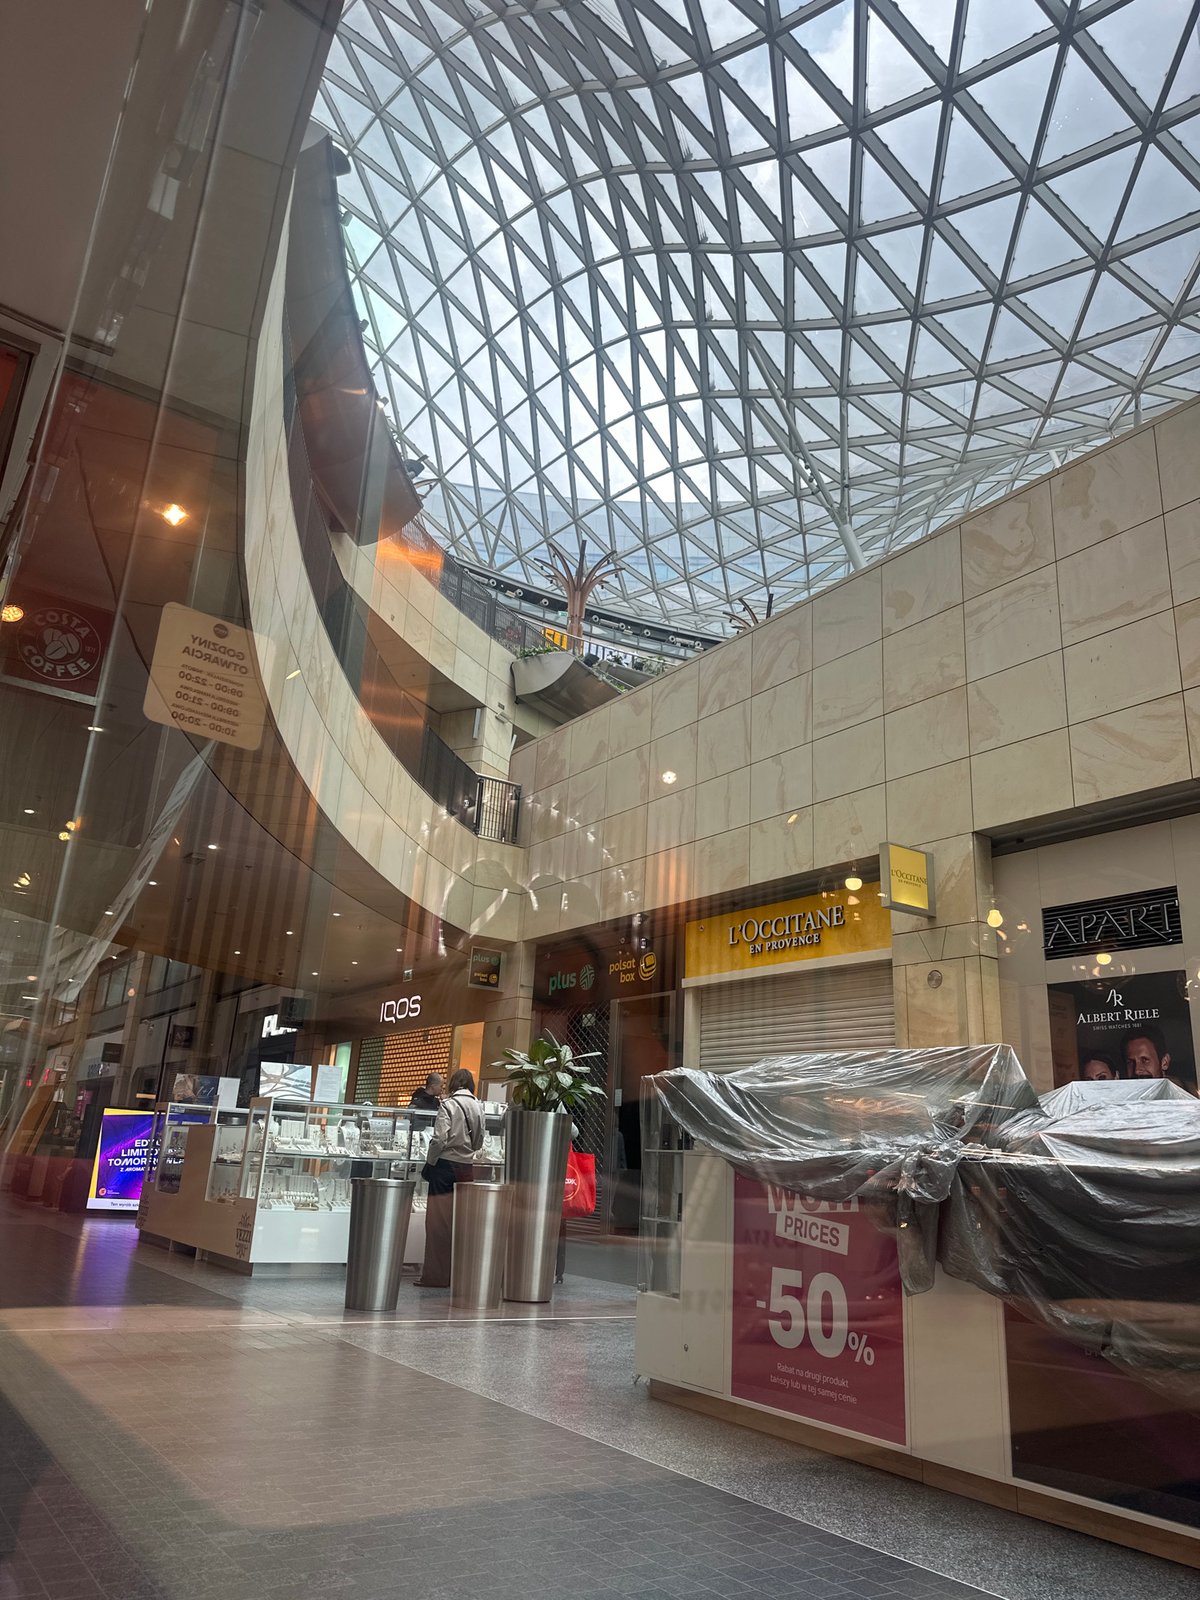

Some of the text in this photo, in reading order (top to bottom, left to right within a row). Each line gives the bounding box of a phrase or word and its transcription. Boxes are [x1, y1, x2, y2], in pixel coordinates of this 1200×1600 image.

[35, 611, 90, 638] COSTA
[24, 645, 91, 677] COFFEE
[728, 905, 845, 945] L'OCCITANE
[1044, 900, 1179, 948] APART
[749, 933, 821, 954] EN PROVENCE
[473, 954, 490, 963] plus
[609, 958, 636, 975] polsat
[548, 971, 577, 995] plus
[620, 972, 635, 983] box
[380, 995, 421, 1024] IQOS
[1077, 1008, 1160, 1025] ALBERT RIELE
[784, 1215, 840, 1247] PRICES
[756, 1266, 876, 1367] -50%
[777, 1362, 849, 1389] Rabat na drugi produkt
[790, 1378, 801, 1390] lub
[801, 1383, 807, 1391] w
[807, 1385, 817, 1397] tej
[817, 1387, 837, 1402] samej
[838, 1391, 858, 1404] cenie
